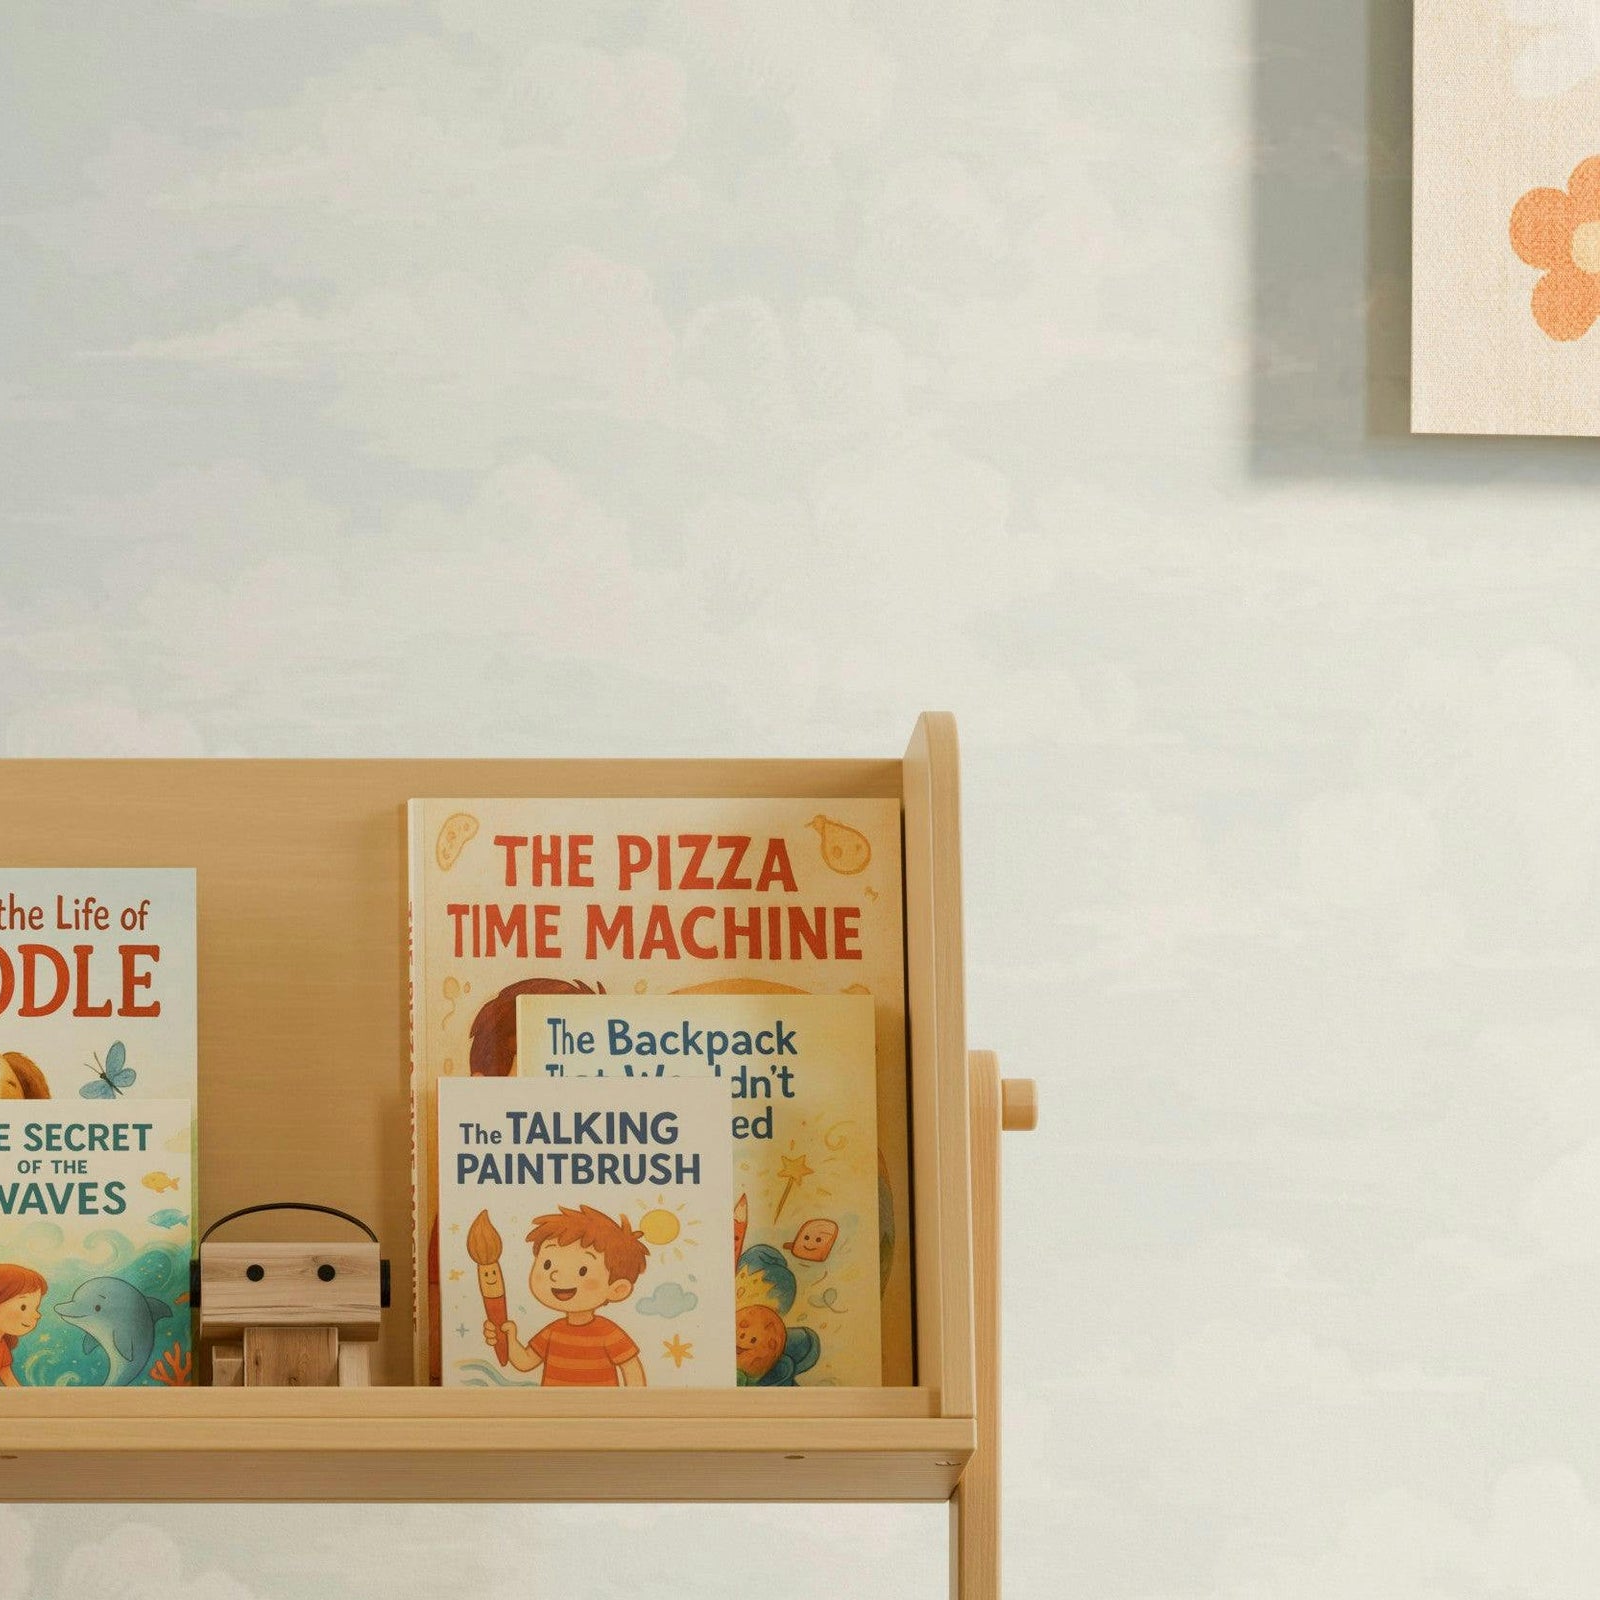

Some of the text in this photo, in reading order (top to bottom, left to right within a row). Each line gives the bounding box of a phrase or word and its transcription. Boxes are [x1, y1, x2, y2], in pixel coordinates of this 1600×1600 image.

[494, 834, 798, 892] THE PIZZA
[56, 895, 110, 931] Life
[120, 899, 151, 931] of
[447, 904, 863, 960] TIME MACHINE
[547, 1018, 798, 1066] The Backpack
[23, 1122, 153, 1153] SECRET
[459, 1111, 679, 1146] The TALKING
[17, 1160, 88, 1175] OF THE
[457, 1152, 700, 1185] PAINTBRUSH
